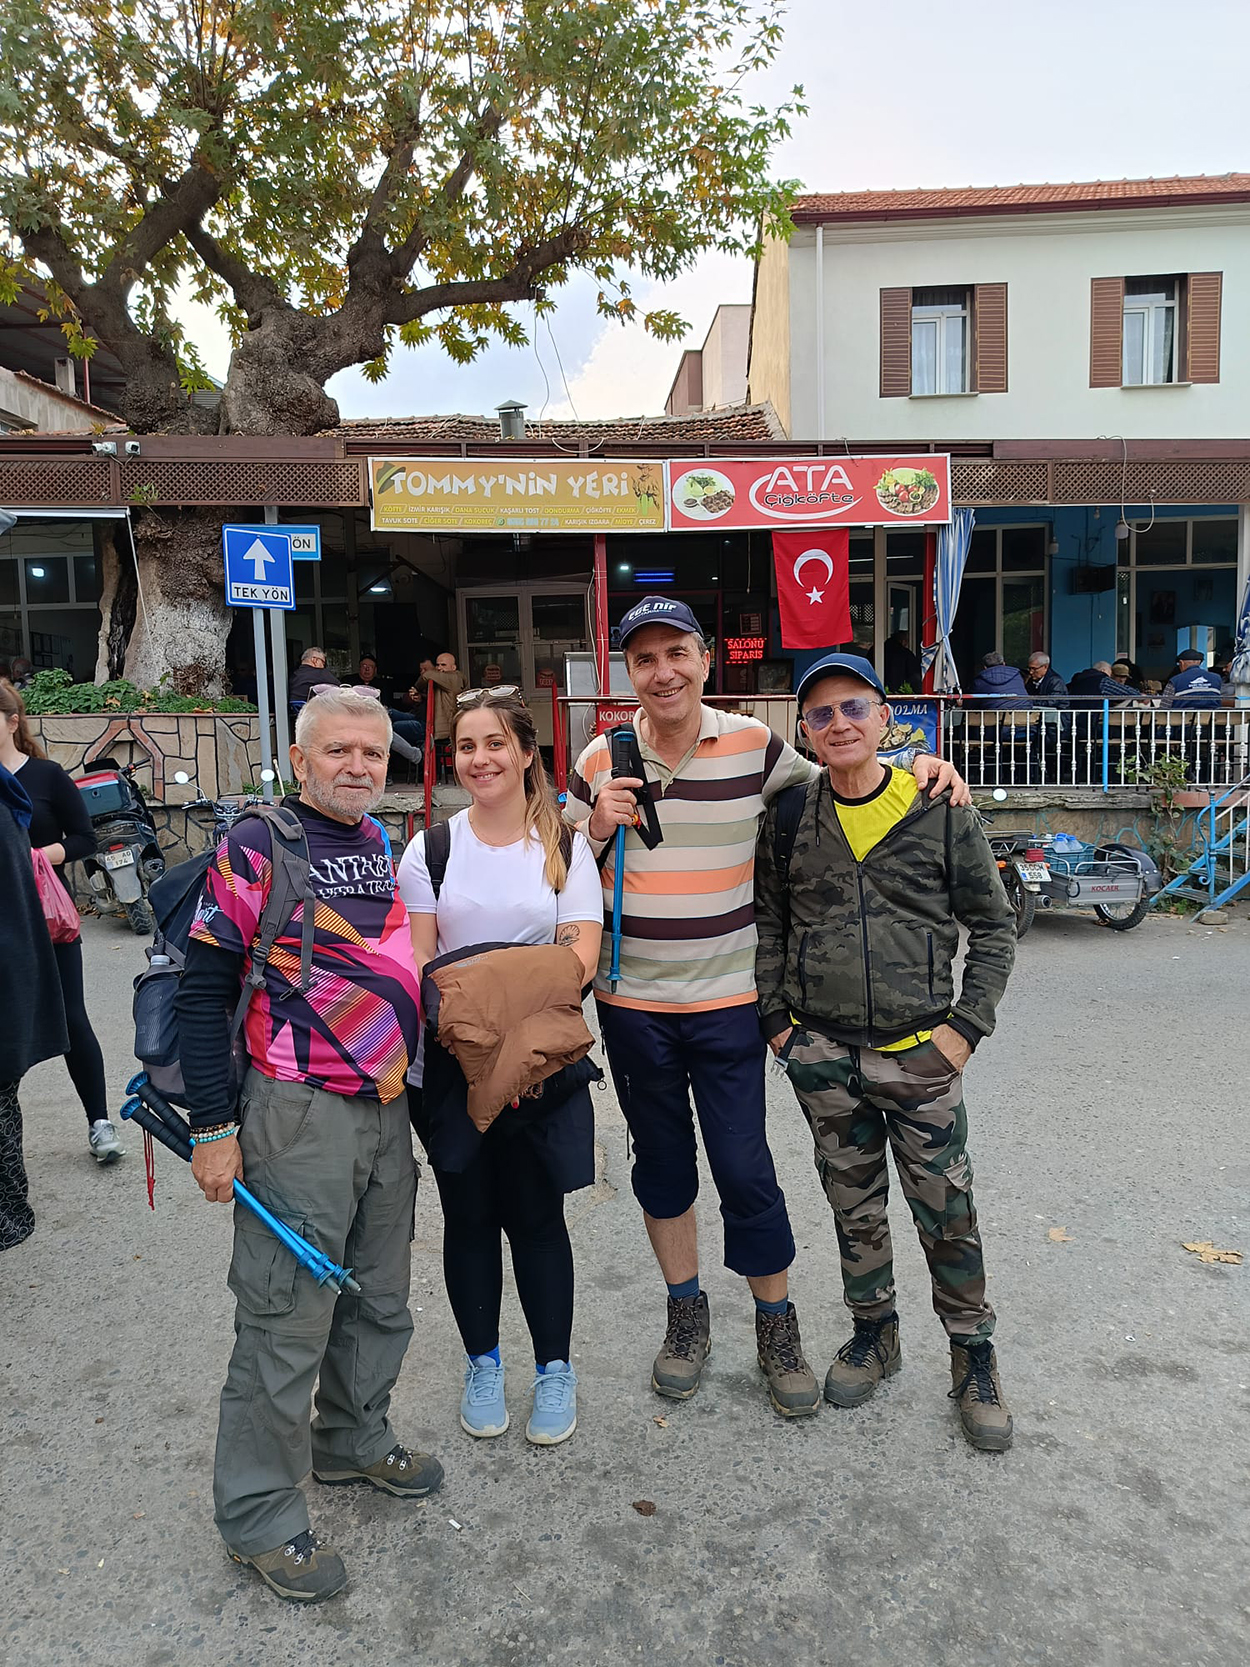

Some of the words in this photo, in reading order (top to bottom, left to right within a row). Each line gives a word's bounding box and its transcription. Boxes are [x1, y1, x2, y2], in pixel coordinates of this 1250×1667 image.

[766, 465, 854, 492] ATA
[764, 492, 854, 507] Çiğköfte
[292, 536, 311, 549] ÖN
[234, 587, 258, 598] TEK
[262, 587, 288, 601] YÖN
[727, 640, 765, 649] SALONU
[599, 711, 635, 722] KOKOR
[893, 704, 928, 716] OLMA
